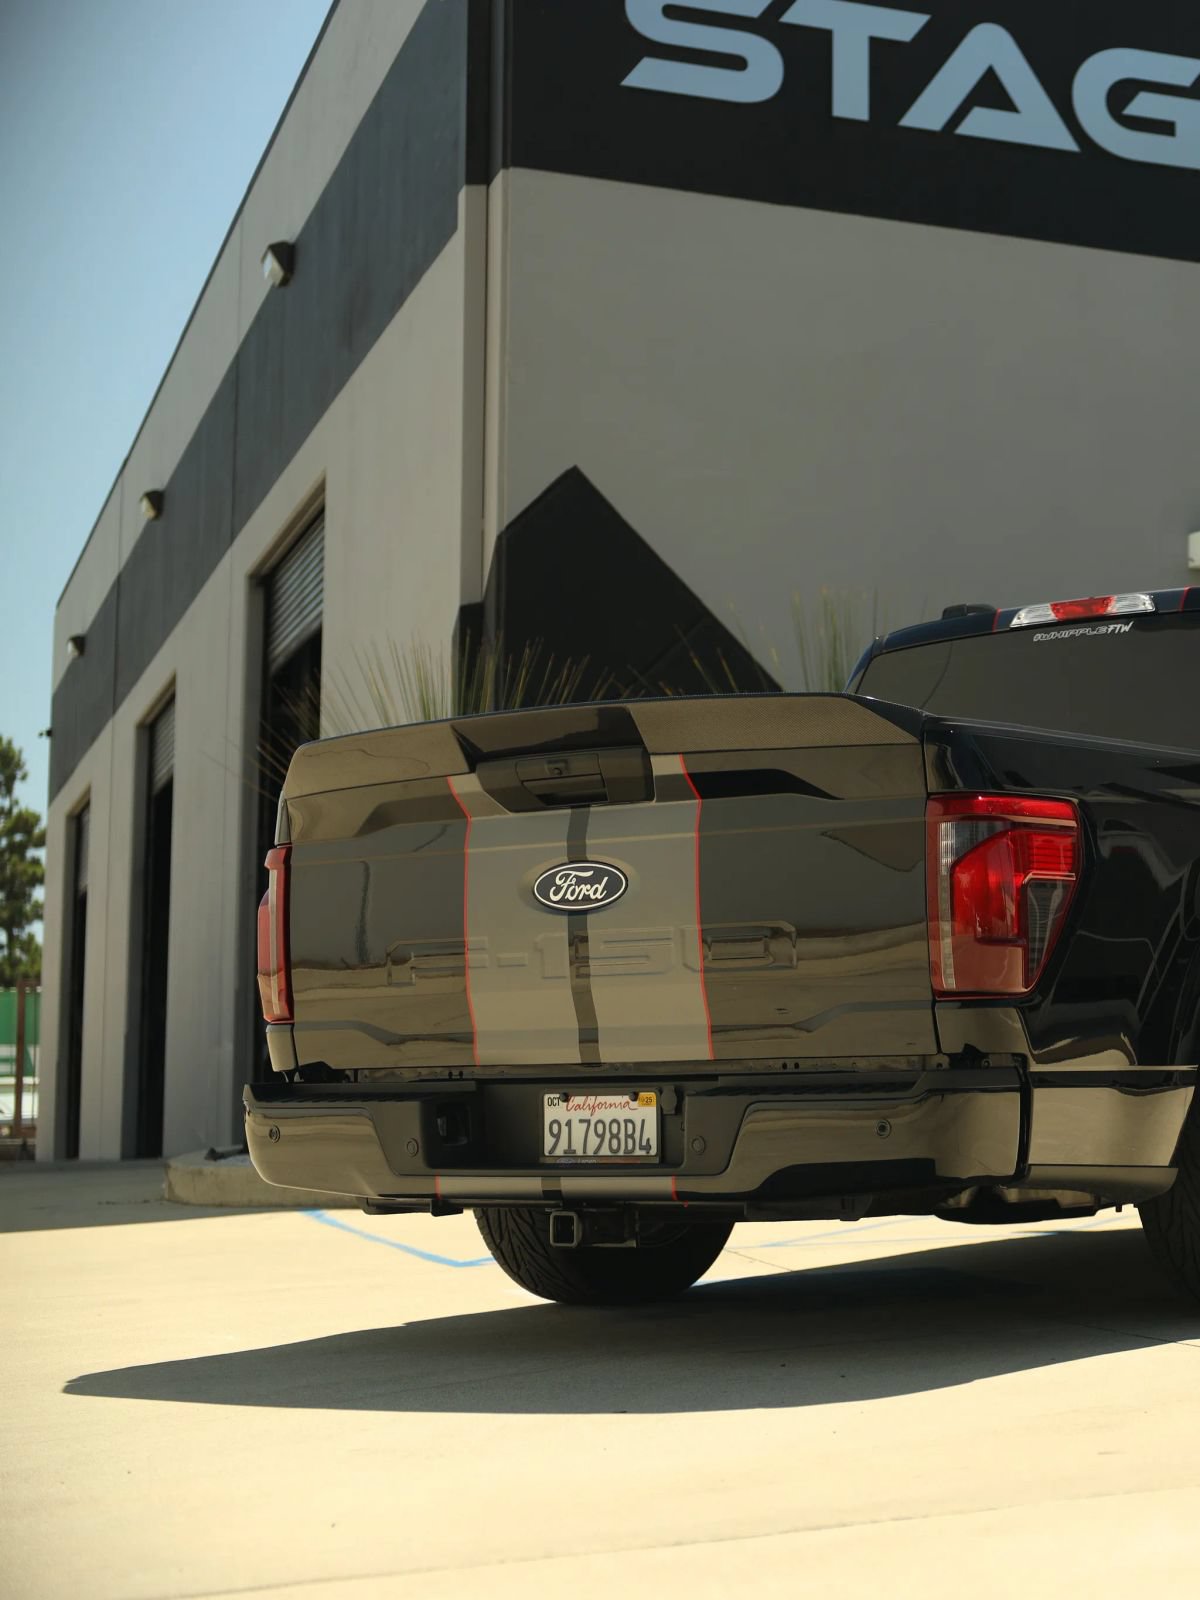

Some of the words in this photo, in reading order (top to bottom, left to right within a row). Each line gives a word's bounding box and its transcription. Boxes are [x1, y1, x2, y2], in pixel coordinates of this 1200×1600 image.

[549, 870, 609, 902] Ford
[386, 920, 798, 986] F-150
[547, 1096, 560, 1107] OCT
[565, 1096, 638, 1117] California
[548, 1118, 652, 1155] 91798B4
